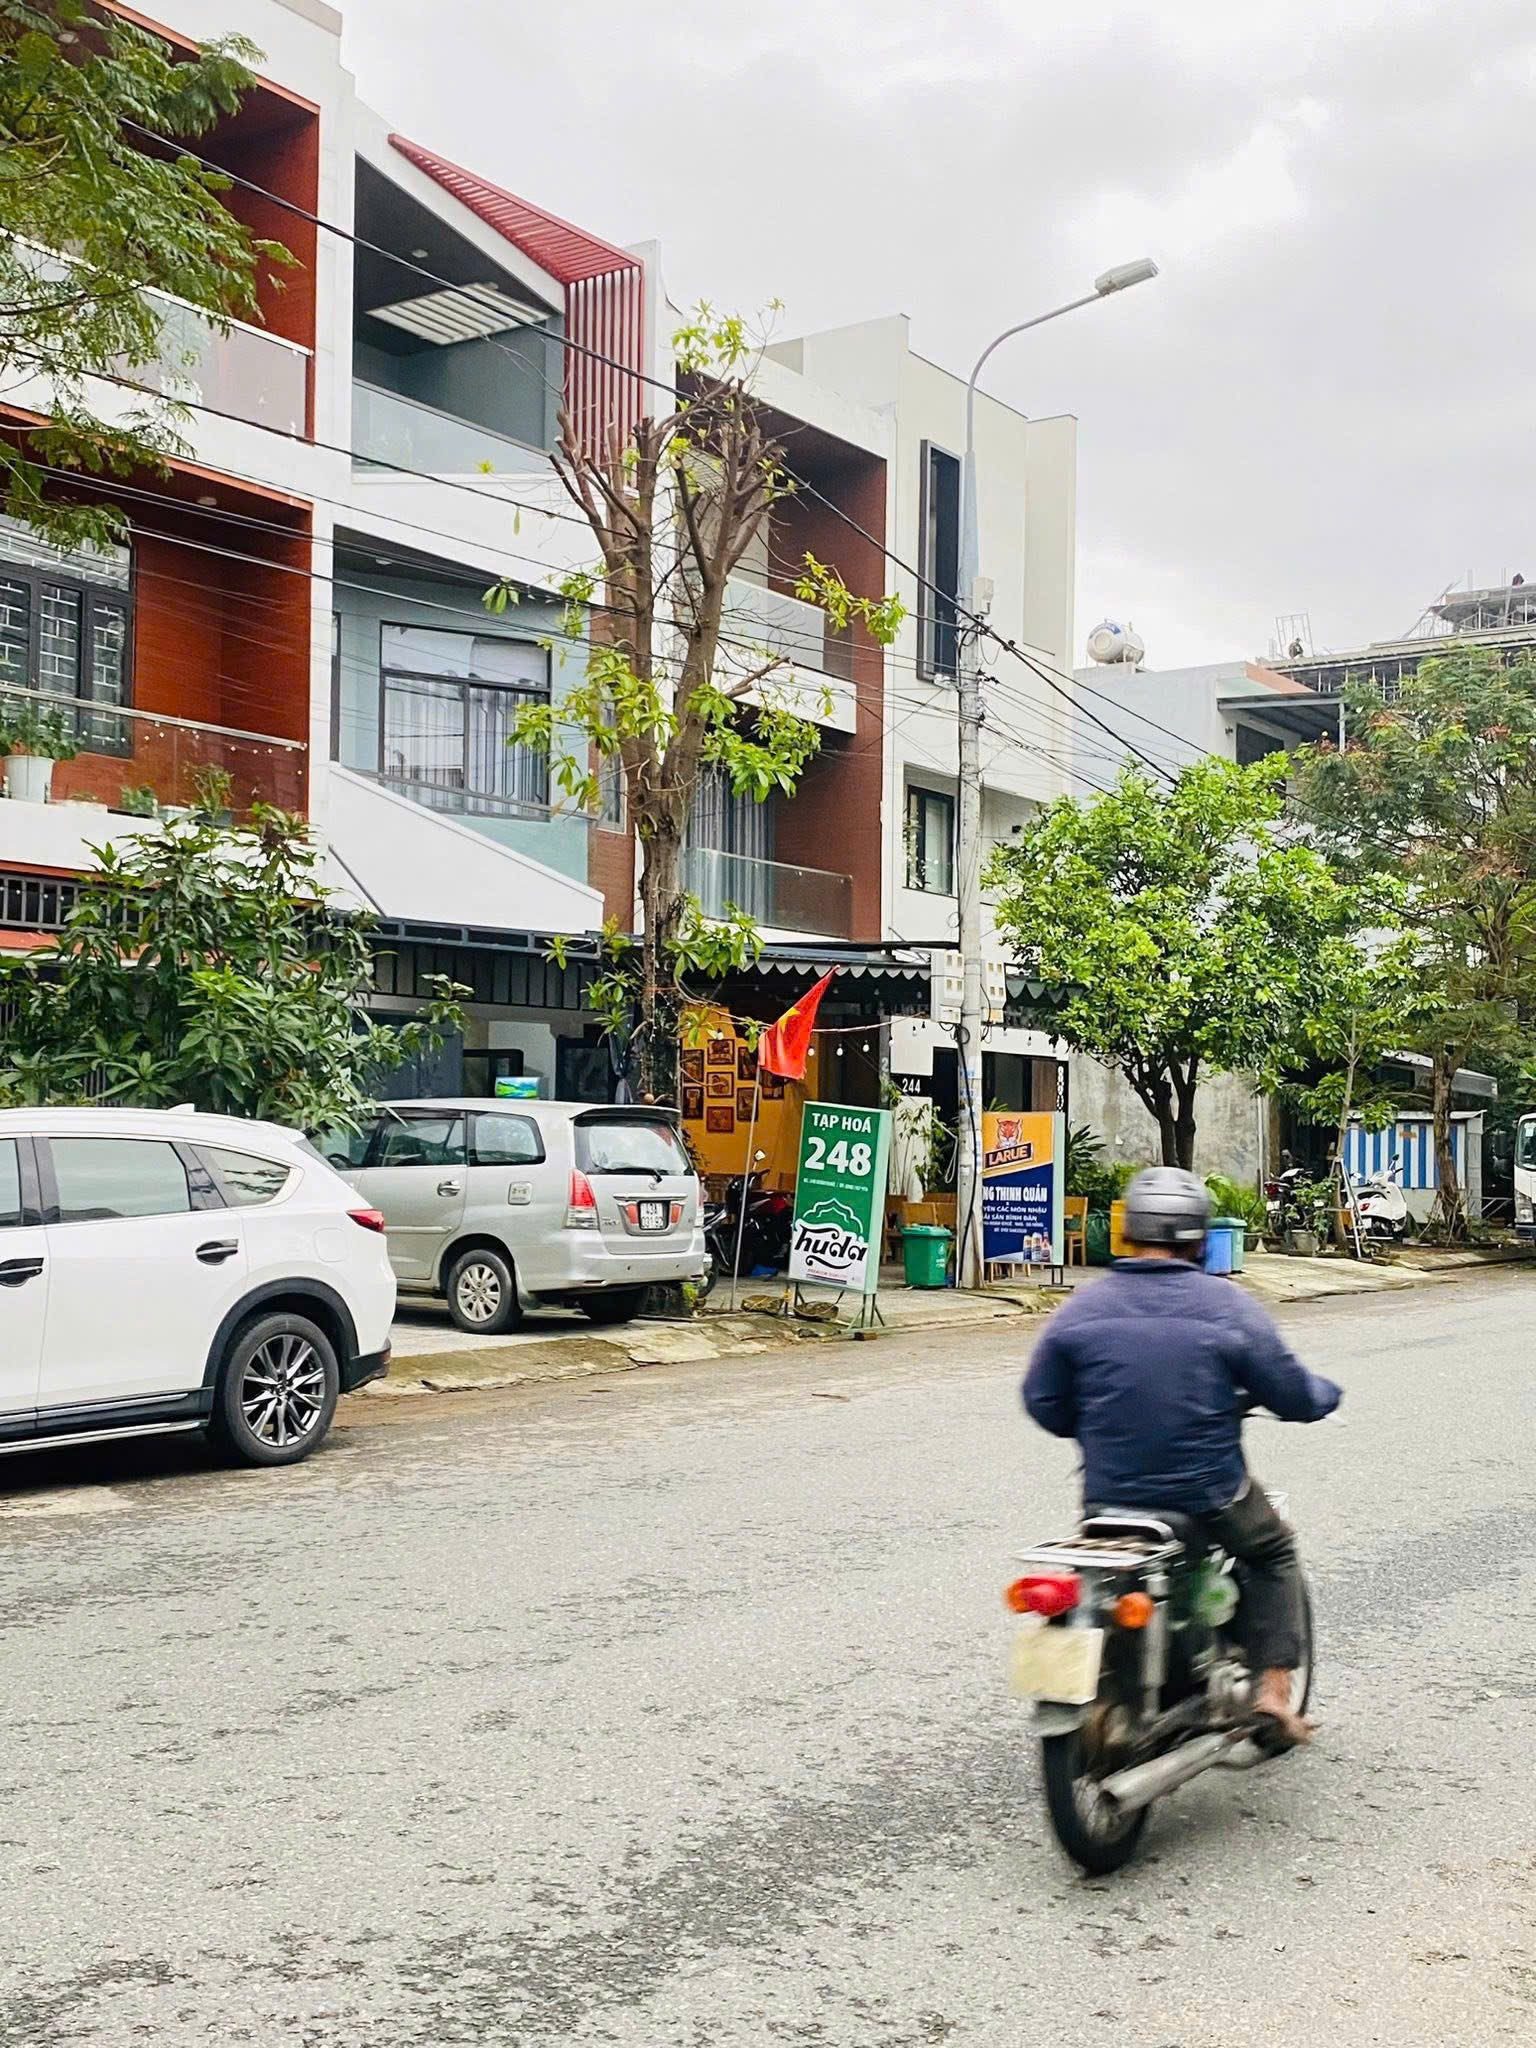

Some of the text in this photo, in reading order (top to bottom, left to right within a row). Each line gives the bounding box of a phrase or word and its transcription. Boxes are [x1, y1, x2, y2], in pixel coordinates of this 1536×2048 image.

[902, 1077, 921, 1094] 244
[811, 1112, 872, 1134] TẠP HOÁ
[804, 1136, 872, 1177] 248
[988, 1146, 1028, 1165] LARUE
[1023, 1184, 1047, 1202] QUÁN
[794, 1224, 868, 1262] huda
